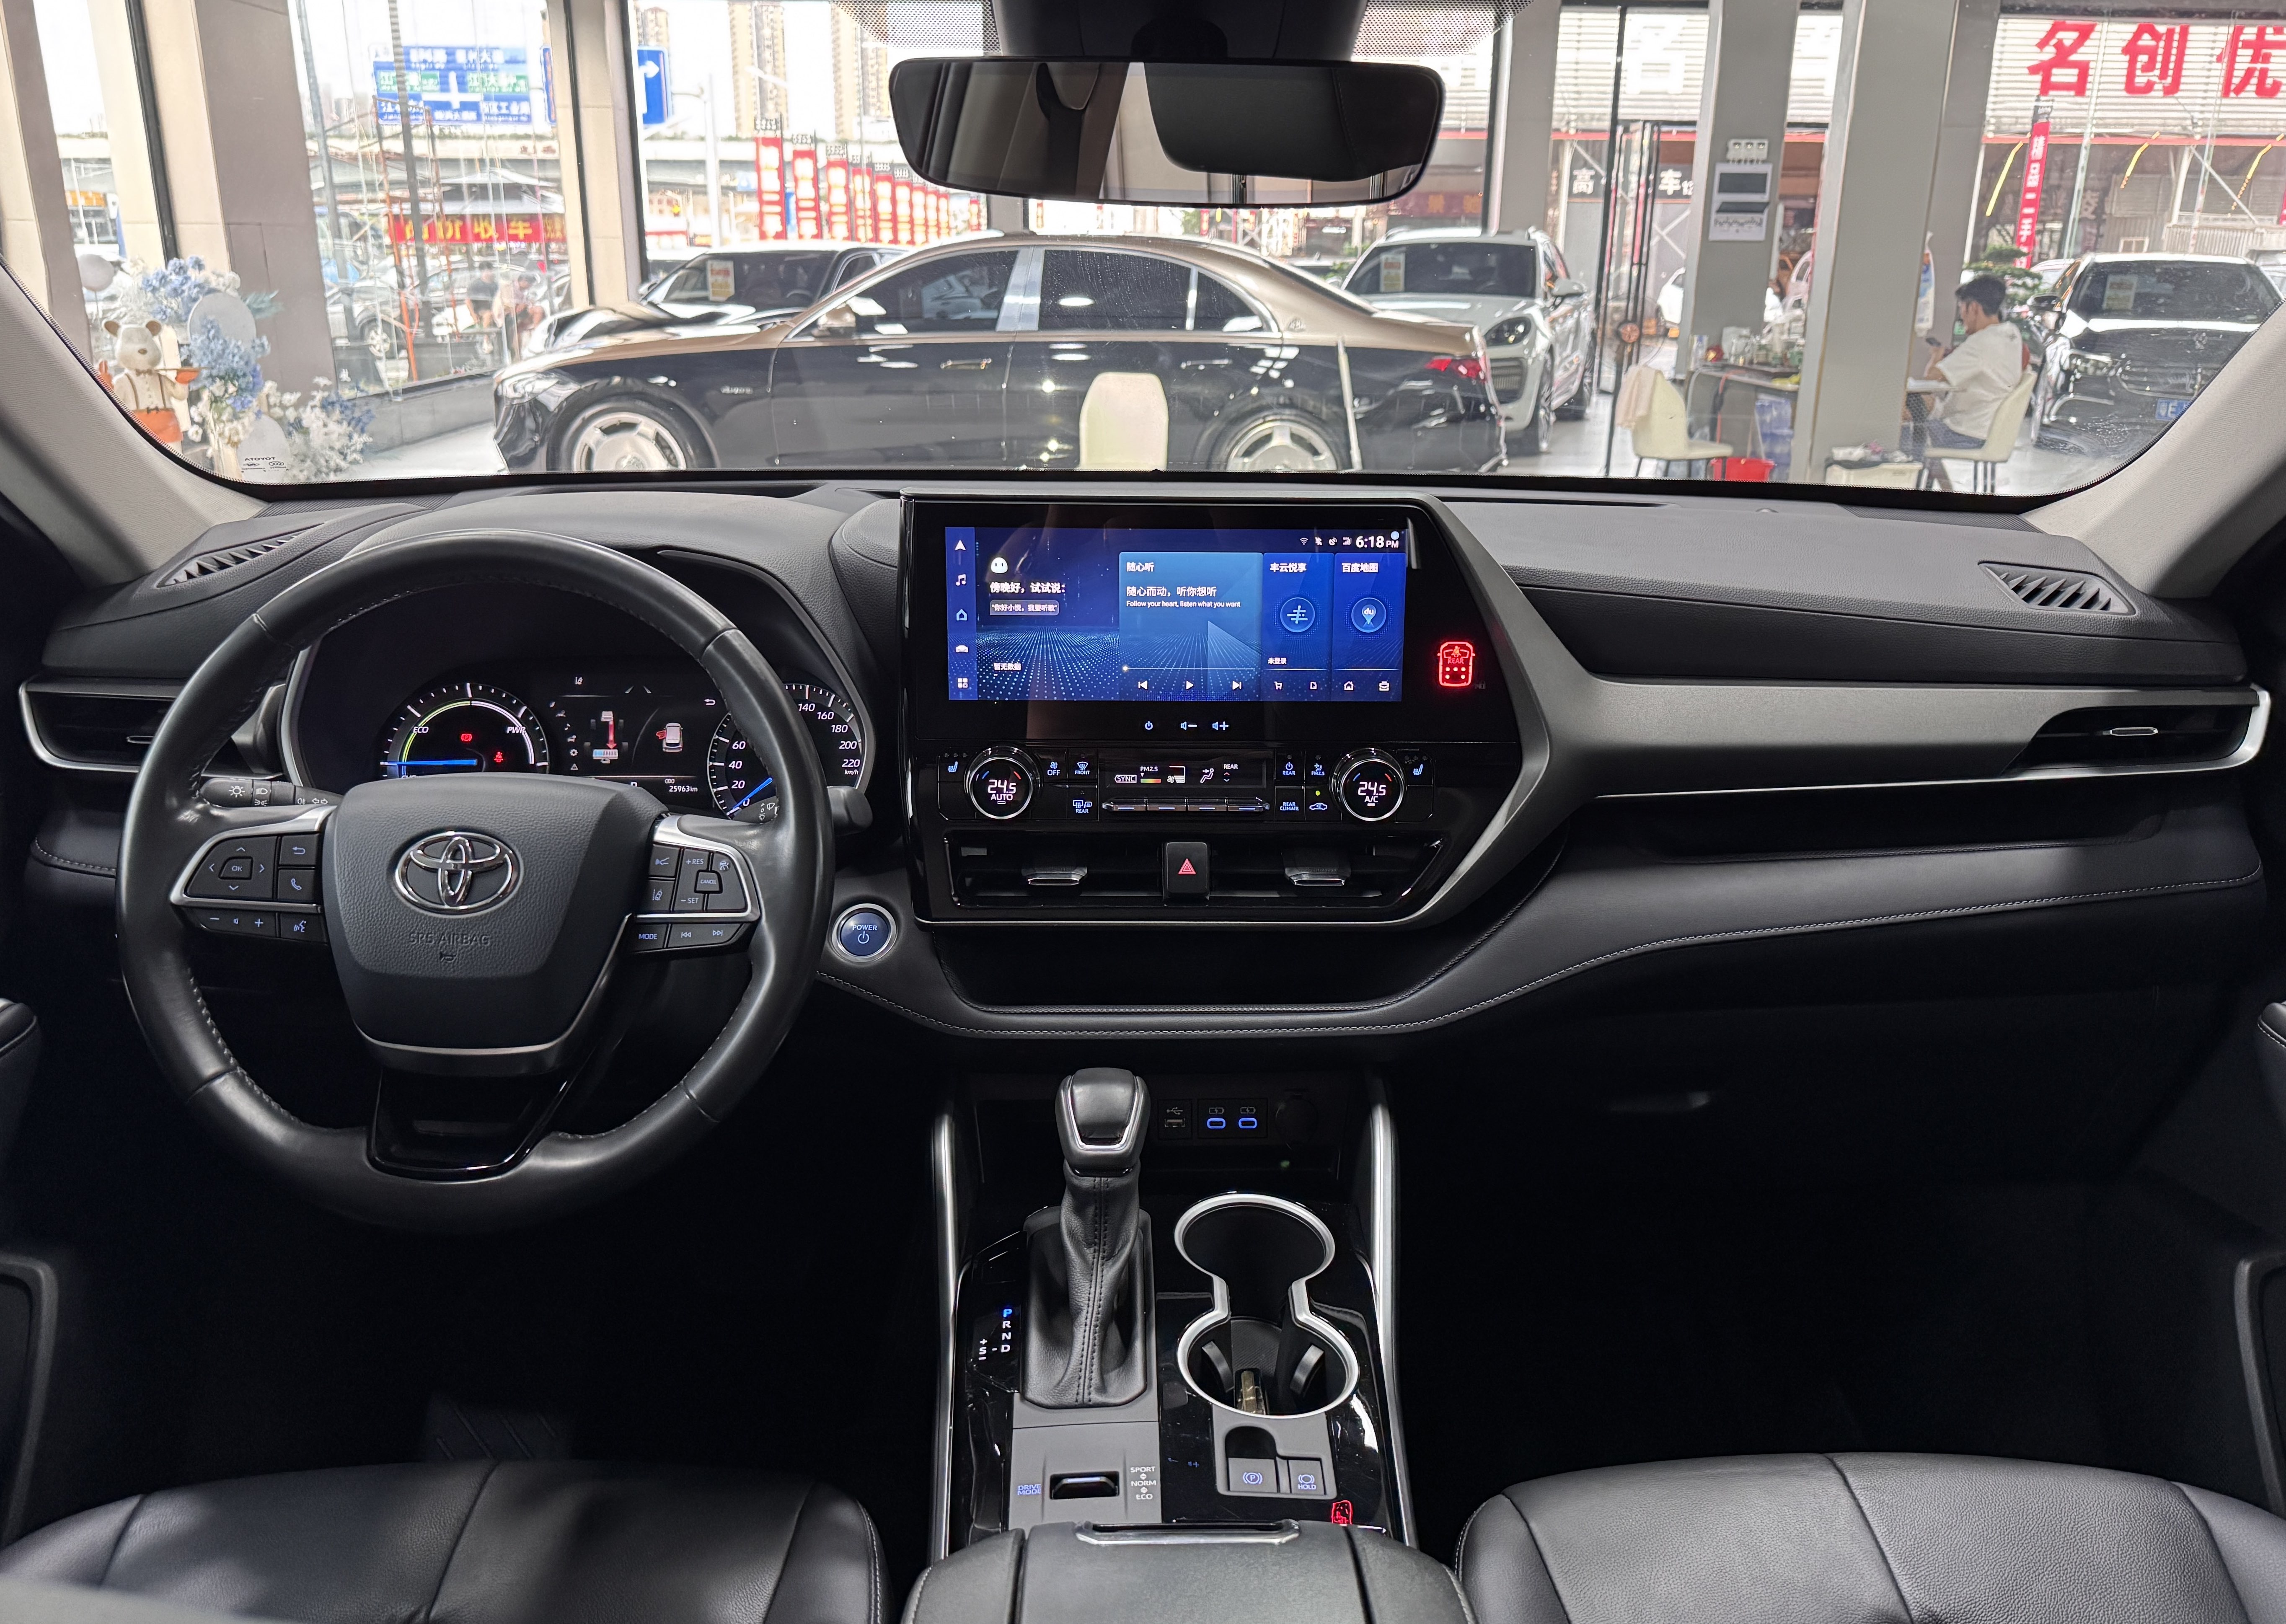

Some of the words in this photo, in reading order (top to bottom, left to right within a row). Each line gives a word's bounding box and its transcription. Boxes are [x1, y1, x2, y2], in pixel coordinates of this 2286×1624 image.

[1355, 535, 1384, 548] 6:18
[1126, 562, 1155, 572] 随心听
[1270, 562, 1307, 573] 丰云悦享
[1342, 563, 1378, 573] 百度地图
[798, 703, 815, 711] 140
[817, 711, 834, 720] 160
[831, 724, 848, 733] 180
[732, 741, 746, 750] 60
[839, 741, 857, 749] 200
[728, 760, 742, 769] 40
[842, 759, 860, 768] 220
[732, 780, 745, 789] 20
[988, 780, 1016, 794] 24.5
[1358, 782, 1386, 796] 24.5
[439, 934, 491, 946] AIRBAG
